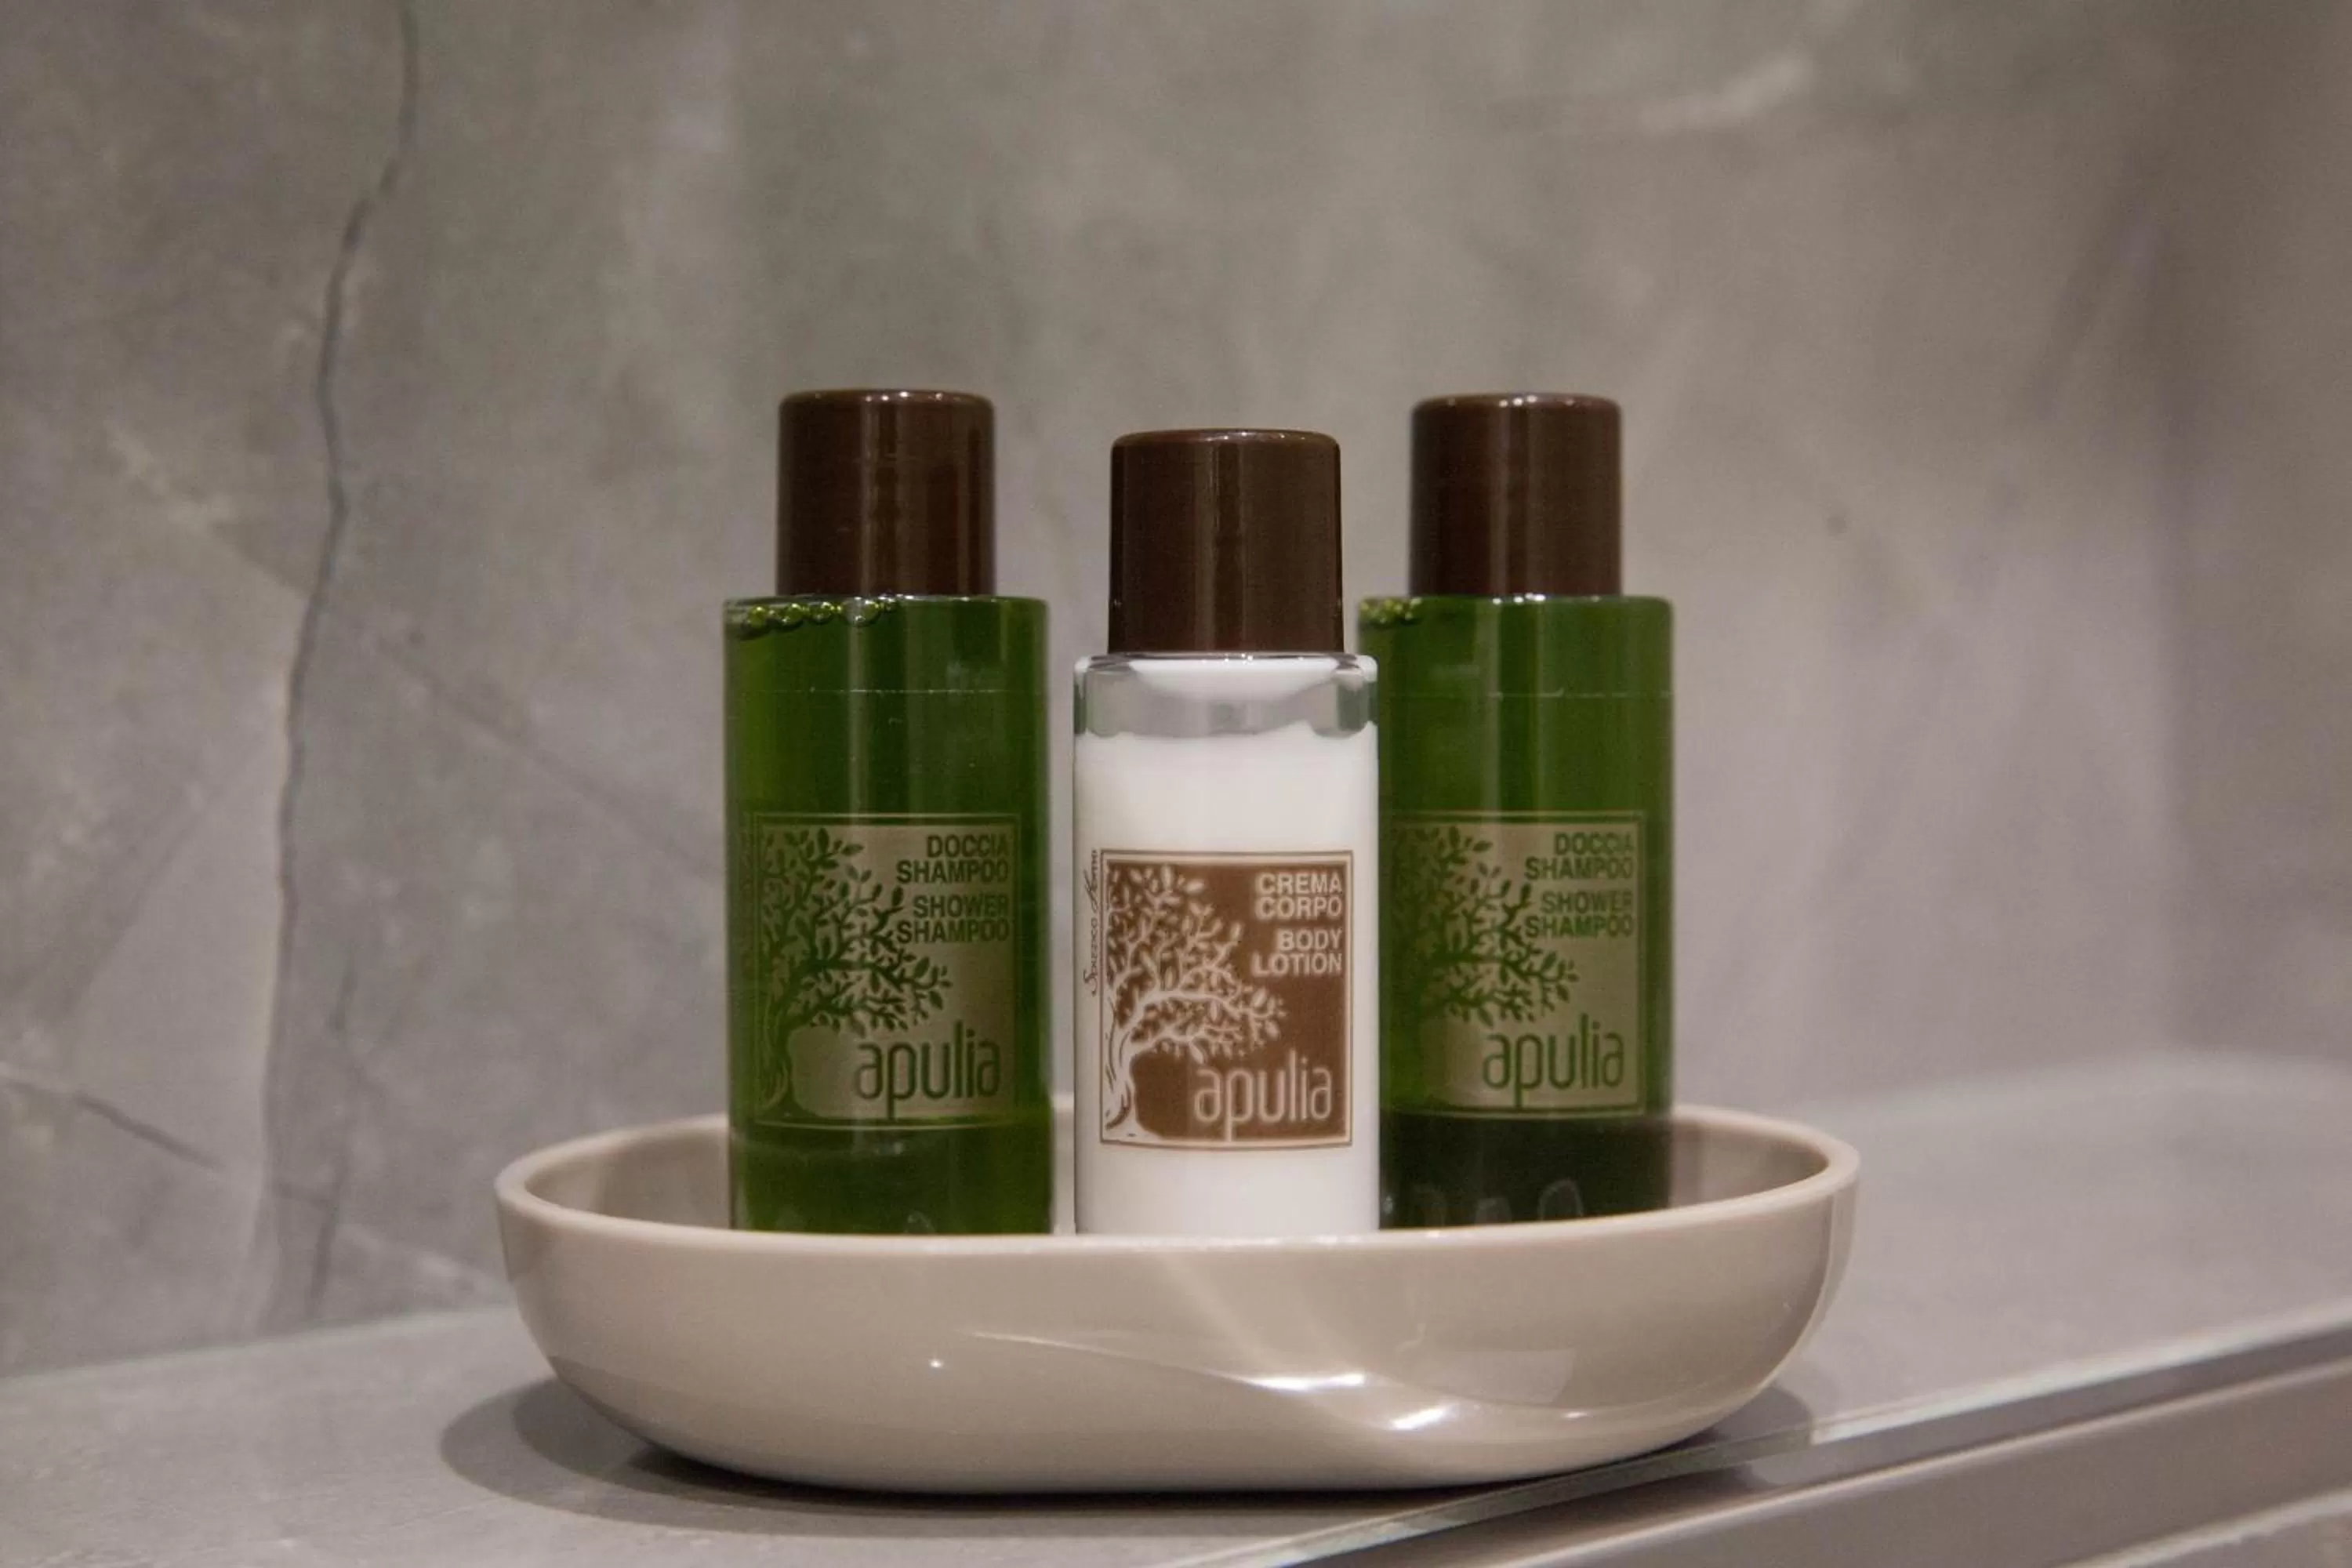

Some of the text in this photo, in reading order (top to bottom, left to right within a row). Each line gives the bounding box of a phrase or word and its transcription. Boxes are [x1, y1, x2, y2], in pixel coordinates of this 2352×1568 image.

[927, 835, 1009, 858] DOCCIA
[1554, 833, 1634, 855] DOCCIA
[896, 860, 1010, 884] SHAMPOO
[1525, 856, 1634, 880] SHAMPOO
[1258, 873, 1343, 895] CREMA
[913, 895, 1010, 918] SHOWER
[1258, 898, 1343, 920] CORPO
[1541, 891, 1633, 914] SHOWER
[896, 920, 1010, 944] SHAMPOO
[1525, 916, 1635, 939] SHAMPOO
[1277, 929, 1343, 952] BODY
[1253, 953, 1343, 977] LOTION
[855, 1022, 1000, 1121] apulia
[1483, 1013, 1624, 1109] apulia
[1194, 1048, 1332, 1142] apulia
